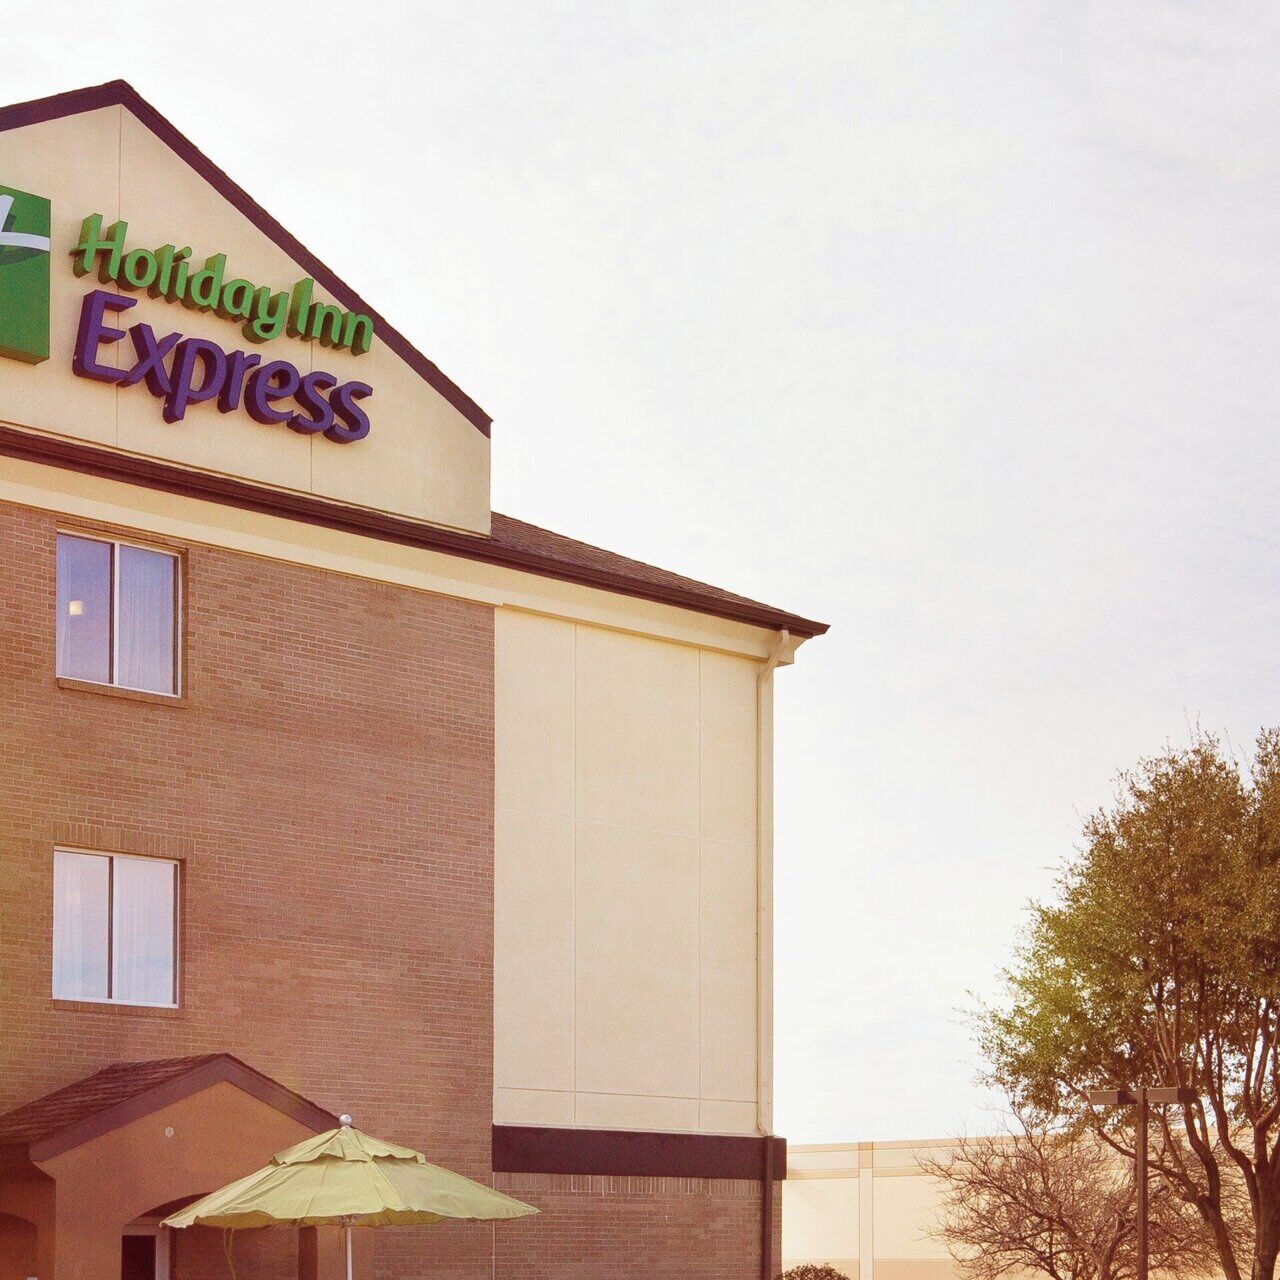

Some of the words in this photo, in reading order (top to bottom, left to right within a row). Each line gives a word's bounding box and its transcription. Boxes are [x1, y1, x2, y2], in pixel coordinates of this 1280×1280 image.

[70, 213, 290, 344] Holiday
[286, 278, 374, 356] Inn
[72, 289, 373, 444] Express
